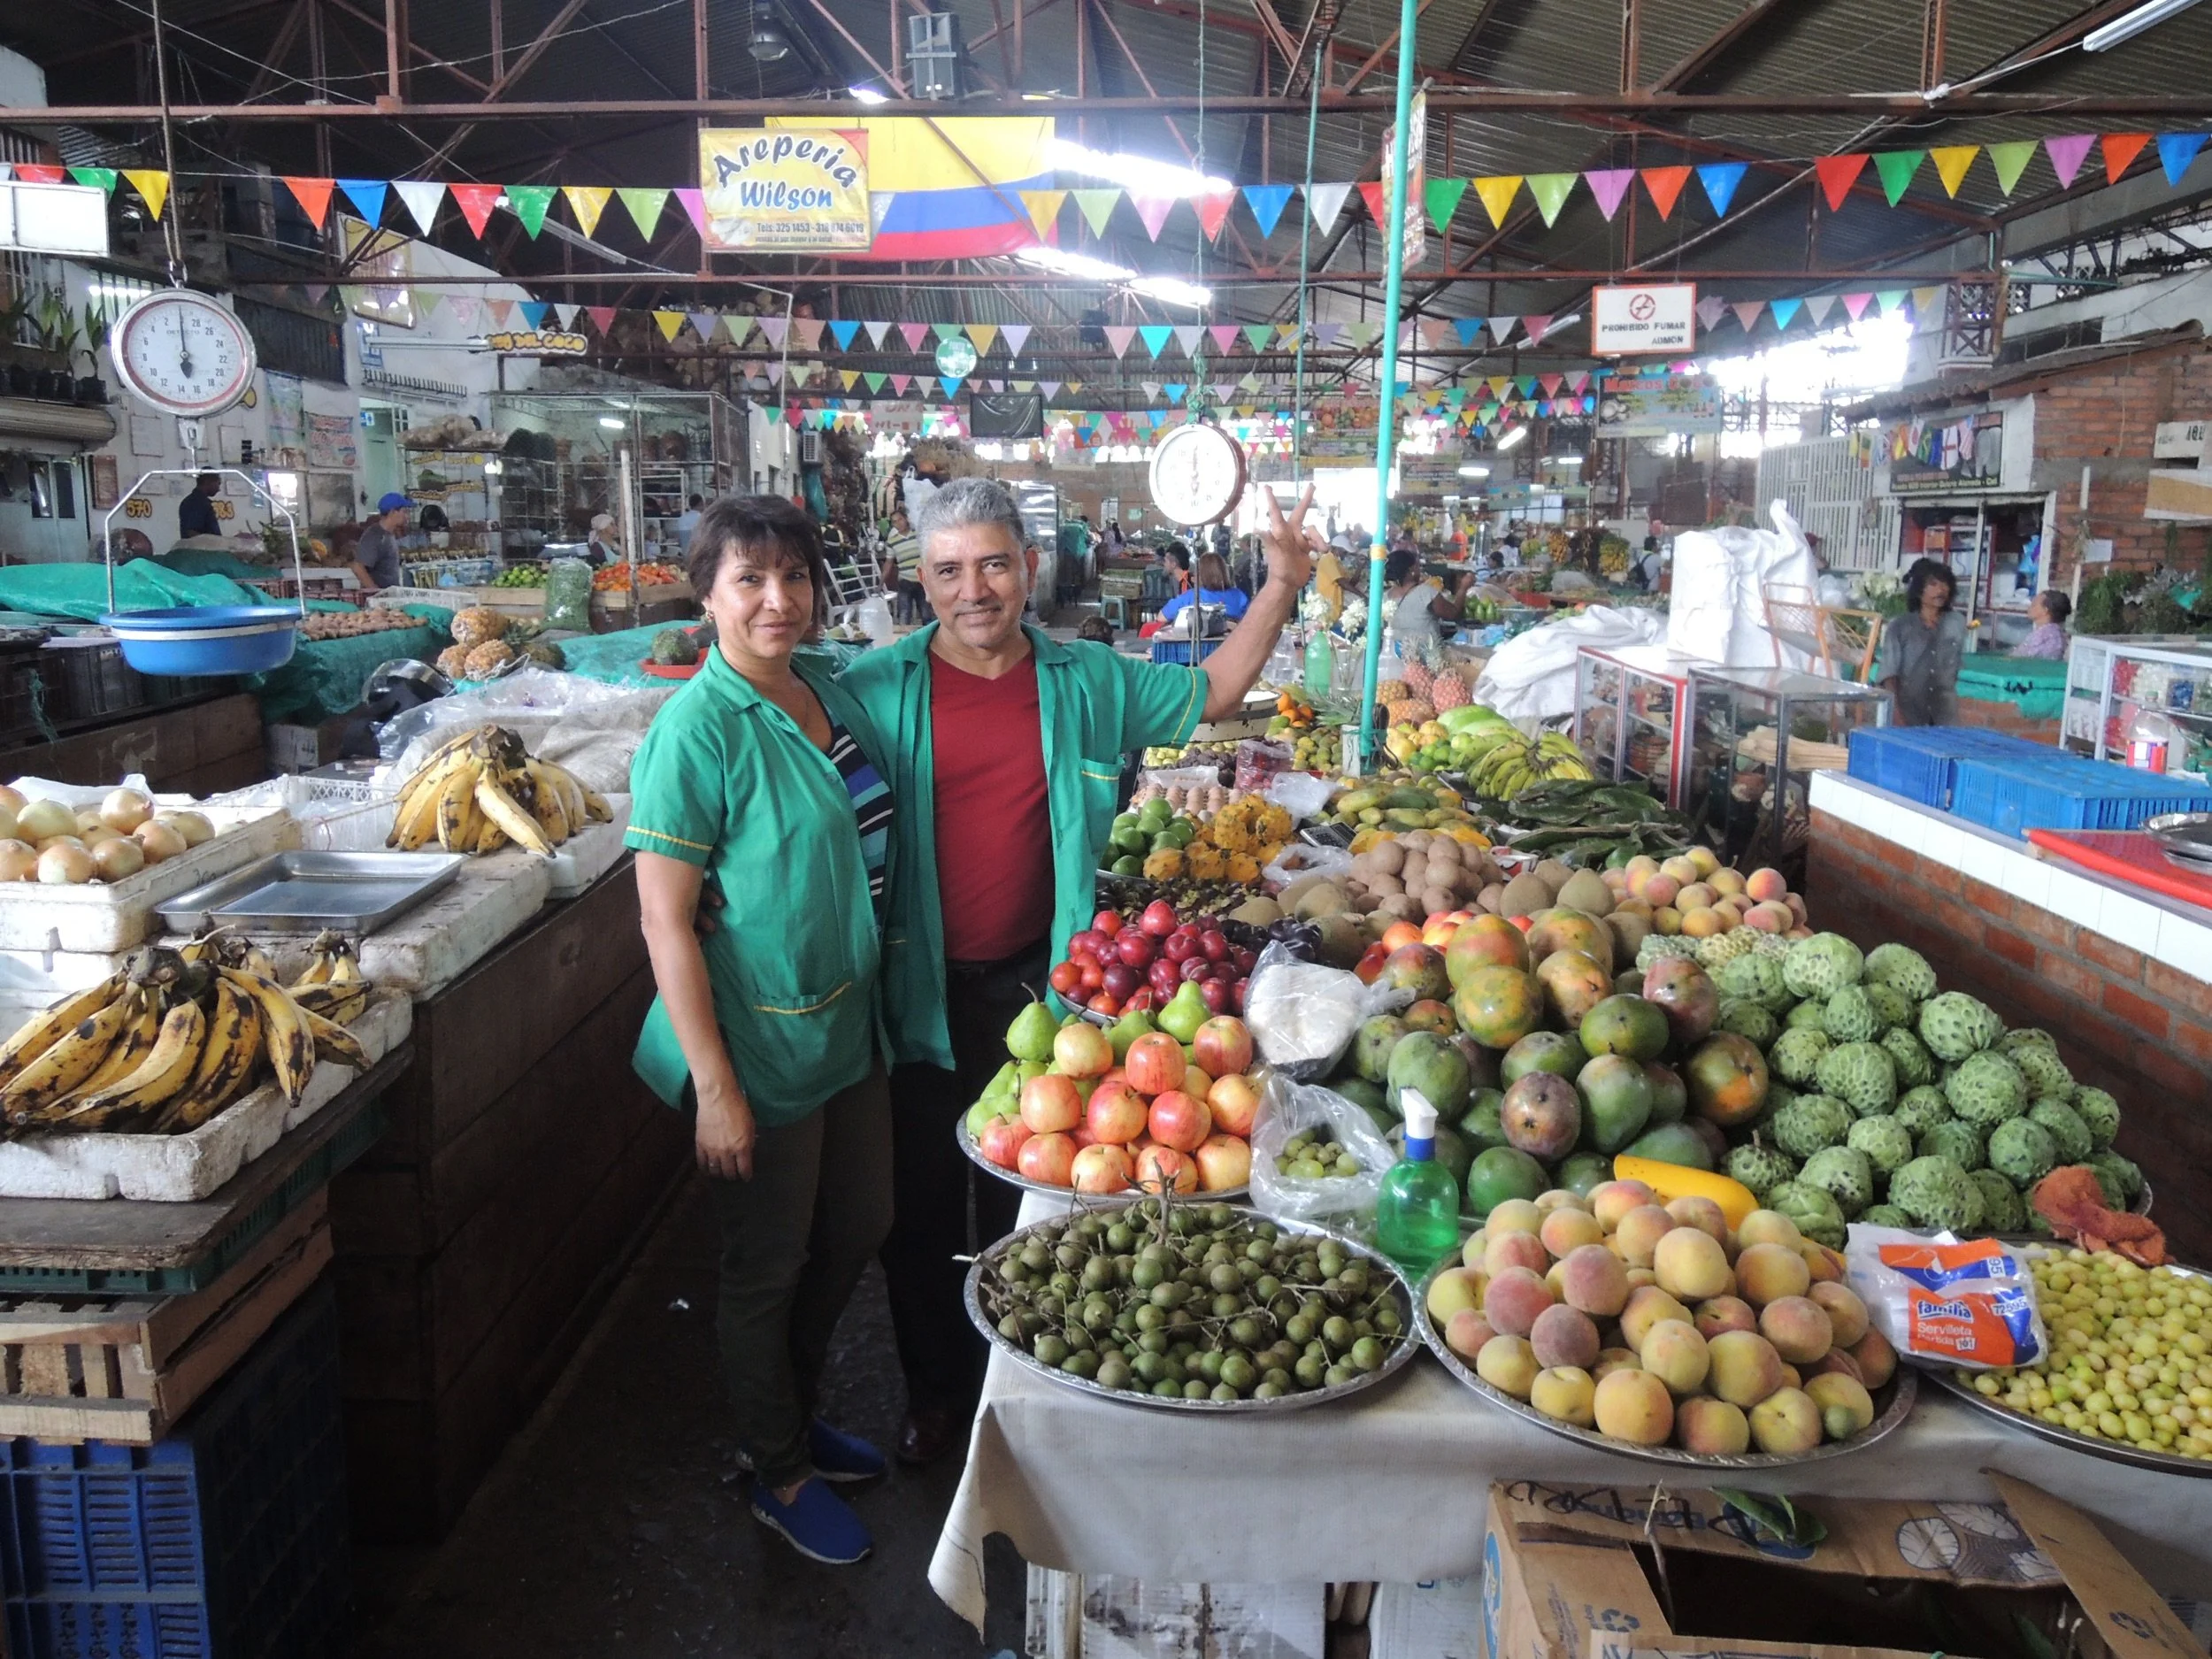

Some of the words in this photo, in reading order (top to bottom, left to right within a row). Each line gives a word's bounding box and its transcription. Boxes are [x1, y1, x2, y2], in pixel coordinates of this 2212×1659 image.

[714, 135, 856, 188] Areperia
[740, 180, 833, 211] Wilson
[192, 319, 201, 327] 28
[1601, 324, 1649, 333] PROHIBIDO
[1654, 321, 1686, 331] FUMAR
[205, 326, 213, 335] 26
[143, 337, 149, 346] 6
[542, 334, 586, 352] COCO
[1651, 335, 1683, 345] ADMON
[219, 355, 227, 364] 22
[150, 367, 157, 376] 10
[160, 378, 167, 387] 12
[178, 385, 185, 394] 14
[193, 385, 201, 394] 16
[126, 498, 152, 518] 570
[1917, 1301, 1971, 1318] familia
[1917, 1322, 1972, 1336] Servilleta
